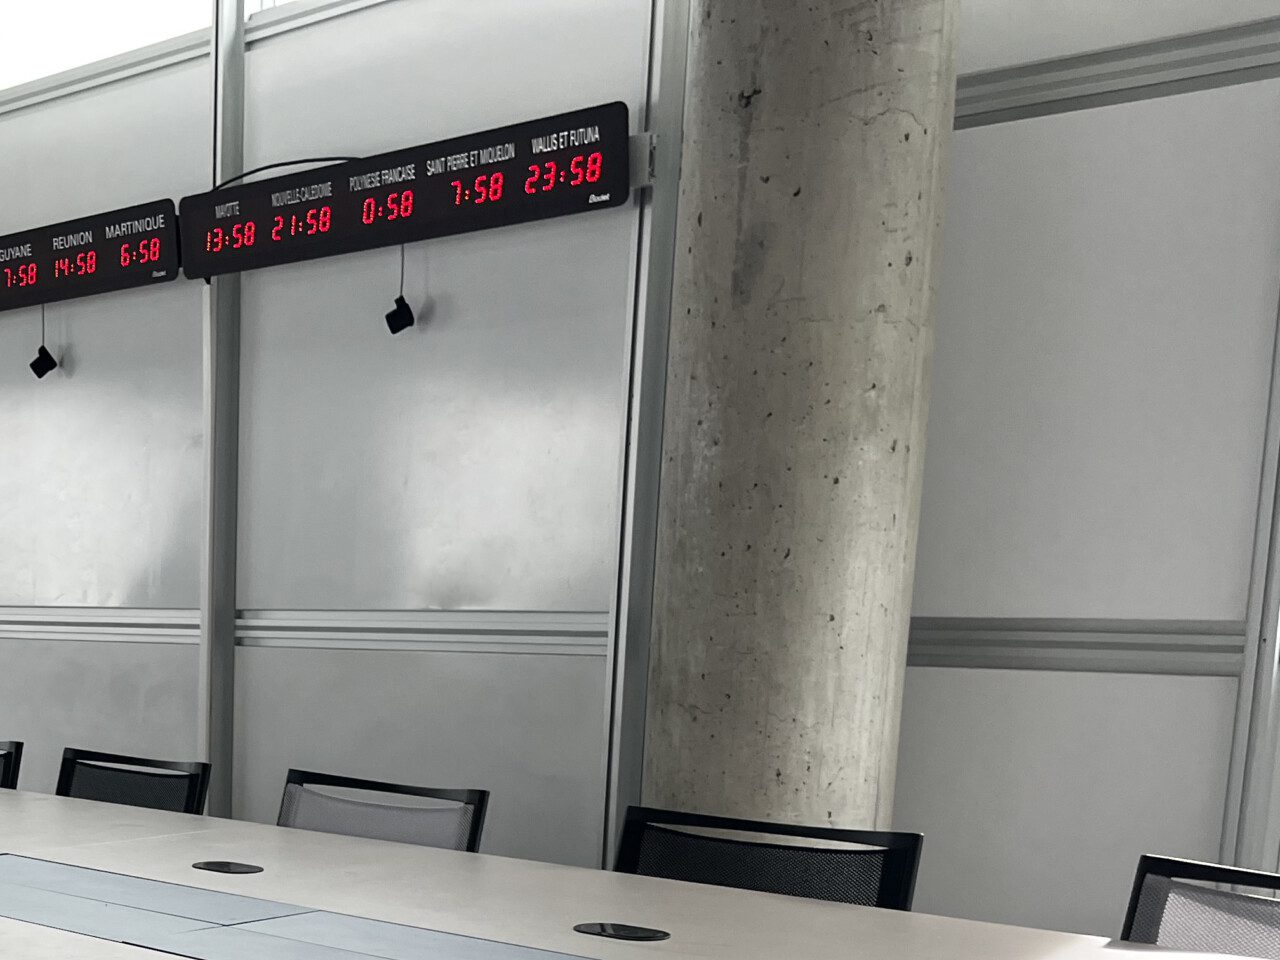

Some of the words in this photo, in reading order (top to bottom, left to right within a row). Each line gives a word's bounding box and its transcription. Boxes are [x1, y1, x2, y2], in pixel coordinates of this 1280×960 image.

[531, 133, 558, 154] WALLIS
[559, 131, 569, 149] ET
[570, 125, 600, 147] FUTUNA
[426, 157, 446, 176] SAINT
[447, 152, 469, 171] PIERRE
[470, 150, 478, 167] ET
[524, 152, 603, 194] 23:58
[450, 172, 504, 205] 7:58
[362, 190, 414, 225] 0:58
[105, 214, 166, 240] MARTINIQUE
[206, 221, 256, 252] 13:58
[271, 206, 332, 241] 21:58
[52, 231, 93, 250] REUNION
[120, 237, 161, 267] 6:58
[4, 263, 37, 288] 7:58
[53, 250, 97, 278] 14:58
